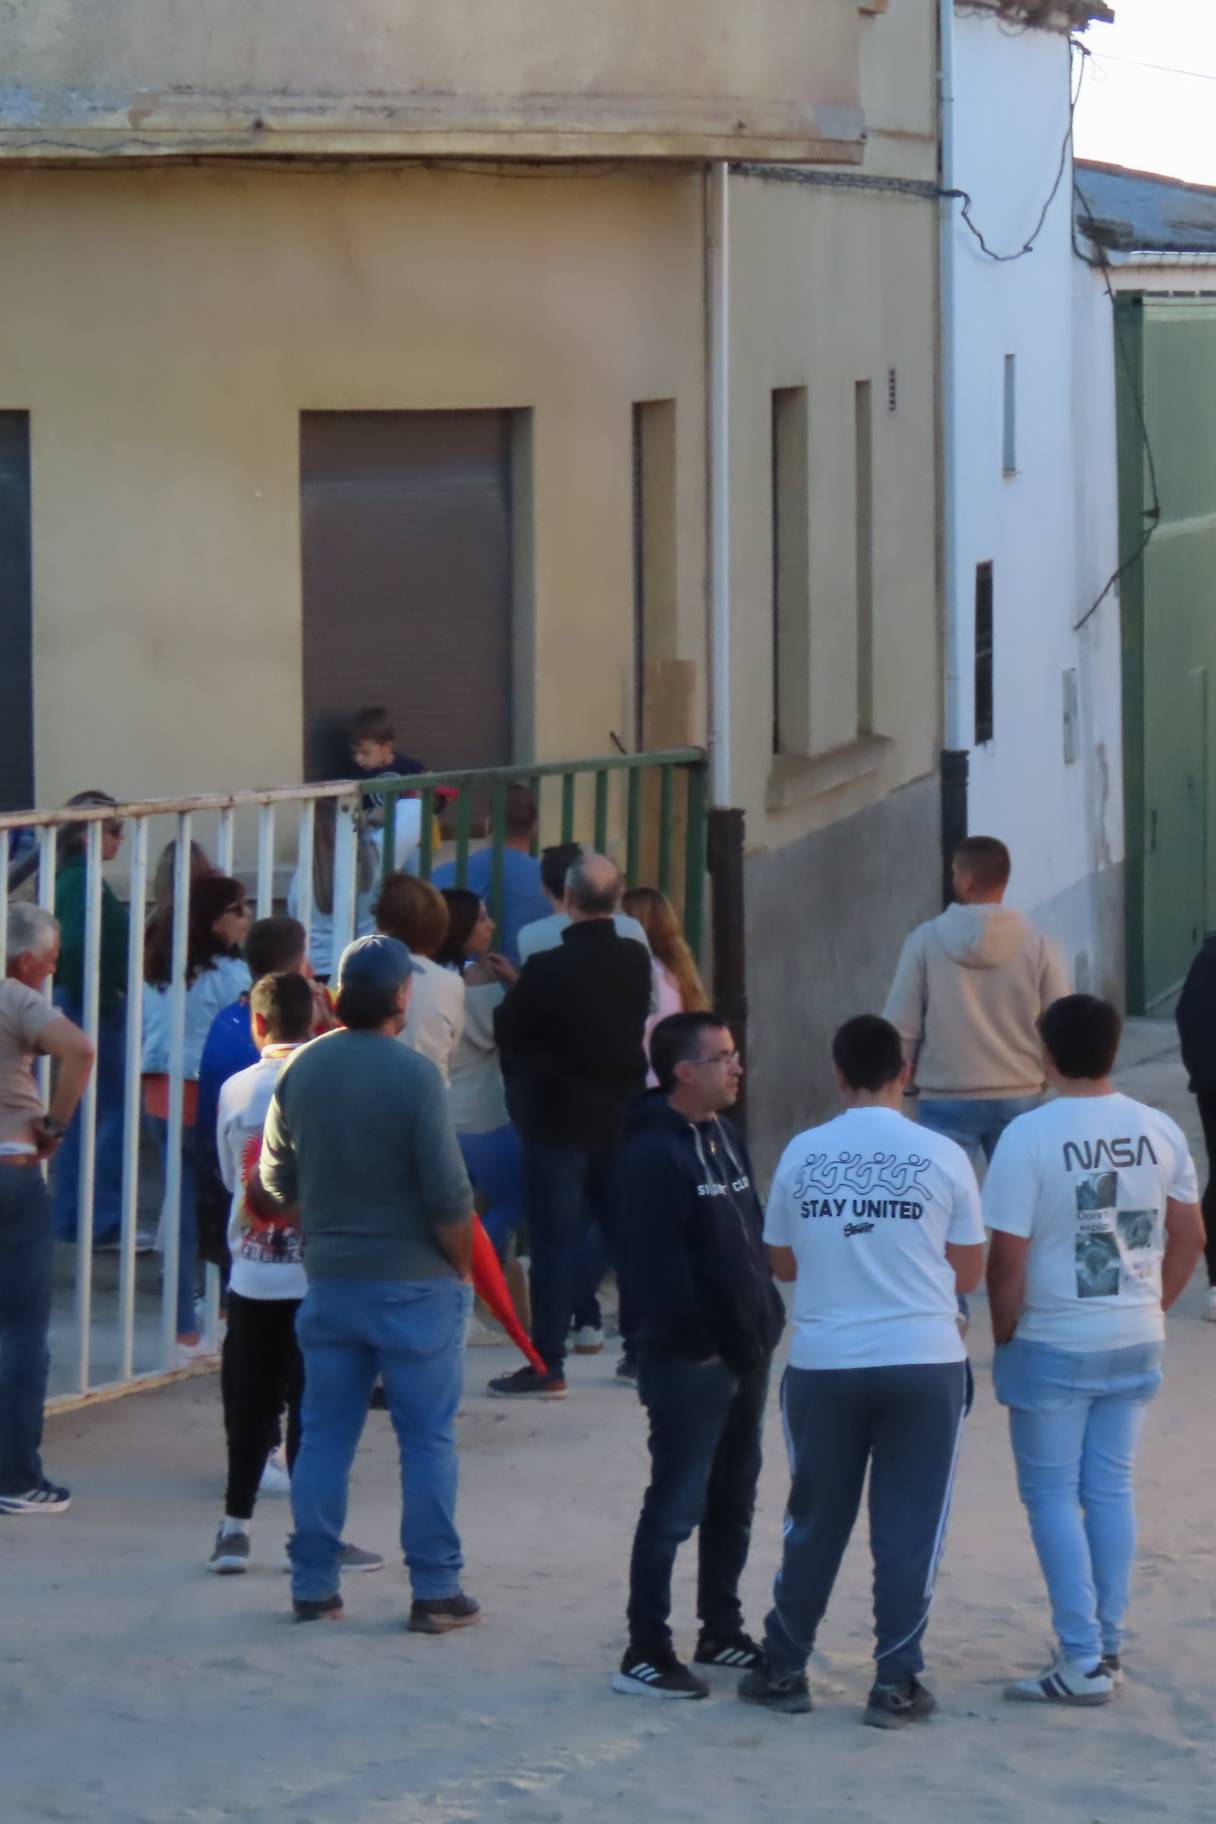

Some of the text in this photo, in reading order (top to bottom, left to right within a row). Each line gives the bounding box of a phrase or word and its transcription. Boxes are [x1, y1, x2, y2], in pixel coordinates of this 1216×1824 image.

[1062, 1135, 1158, 1171] NASA
[800, 1198, 924, 1221] STAY UNITED
